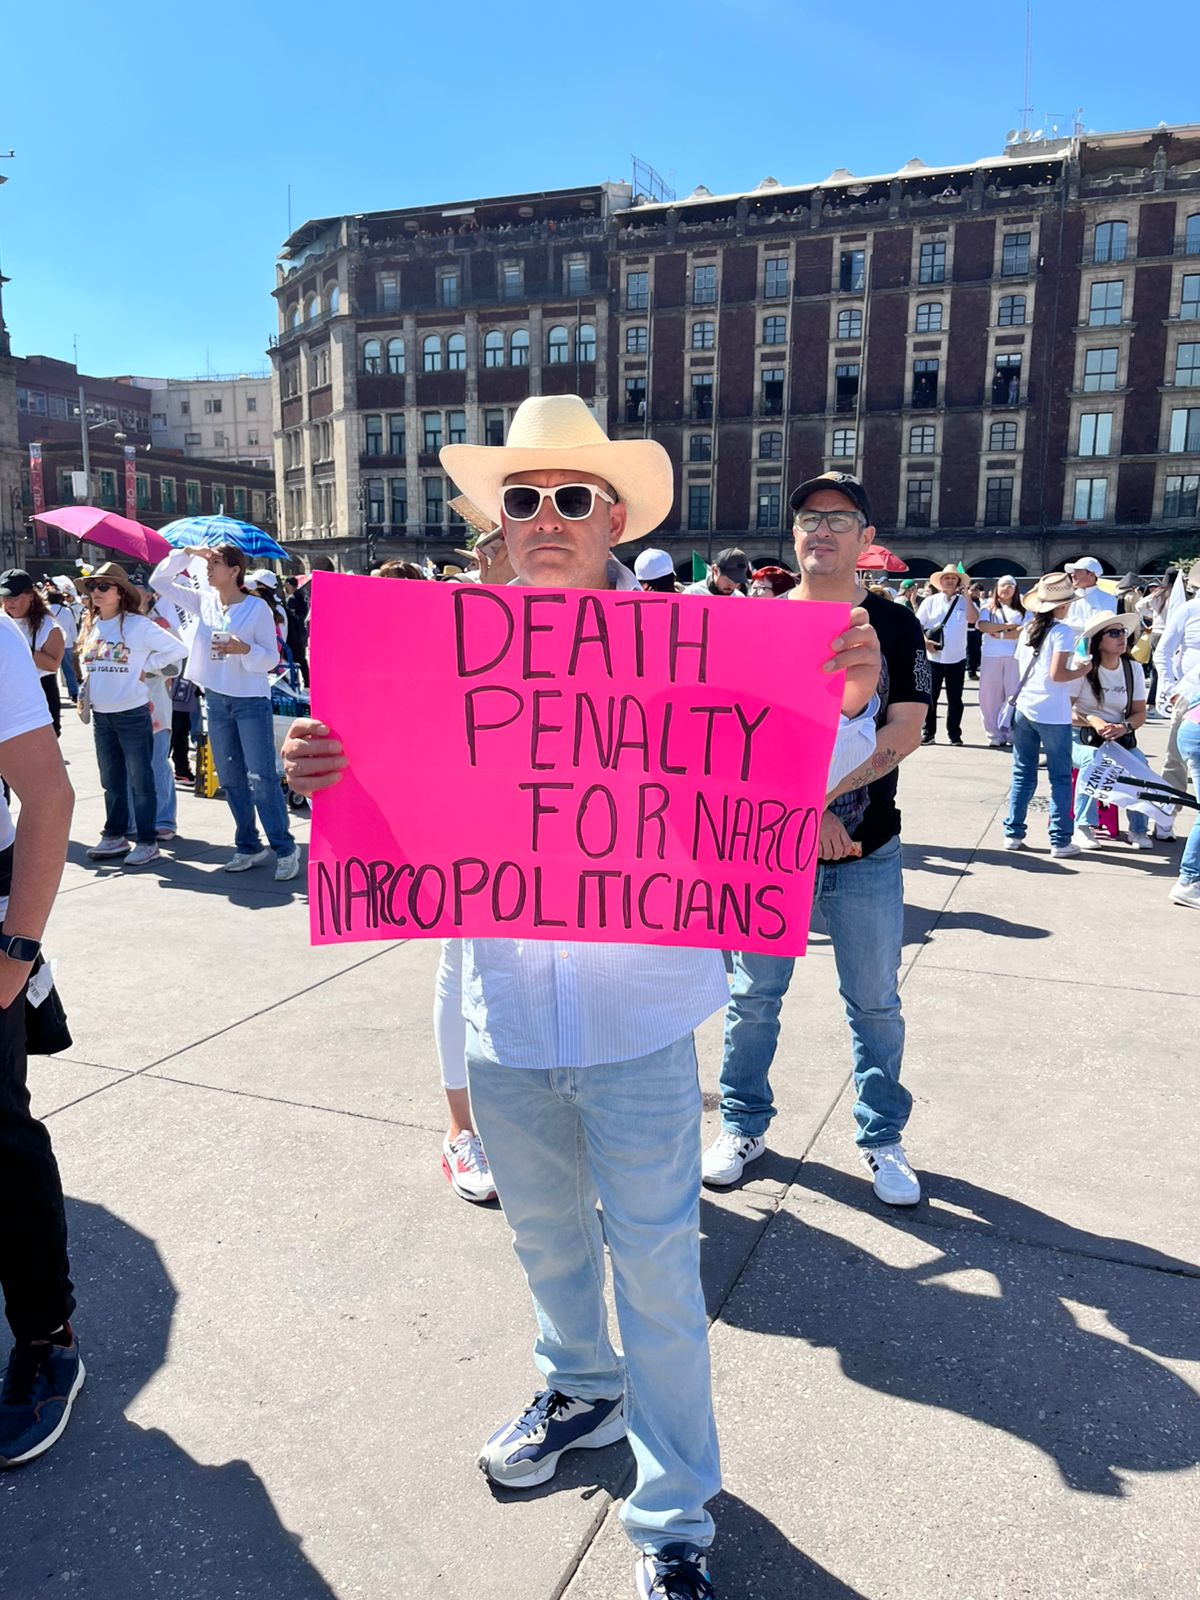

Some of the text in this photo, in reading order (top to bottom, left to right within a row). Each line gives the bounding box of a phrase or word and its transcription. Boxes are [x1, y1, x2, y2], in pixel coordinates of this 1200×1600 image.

[452, 587, 708, 684] DEATH
[464, 686, 770, 782] PENALTY
[518, 782, 818, 874] FOR NARCO
[317, 856, 787, 940] NARCOPOLITICIANS
